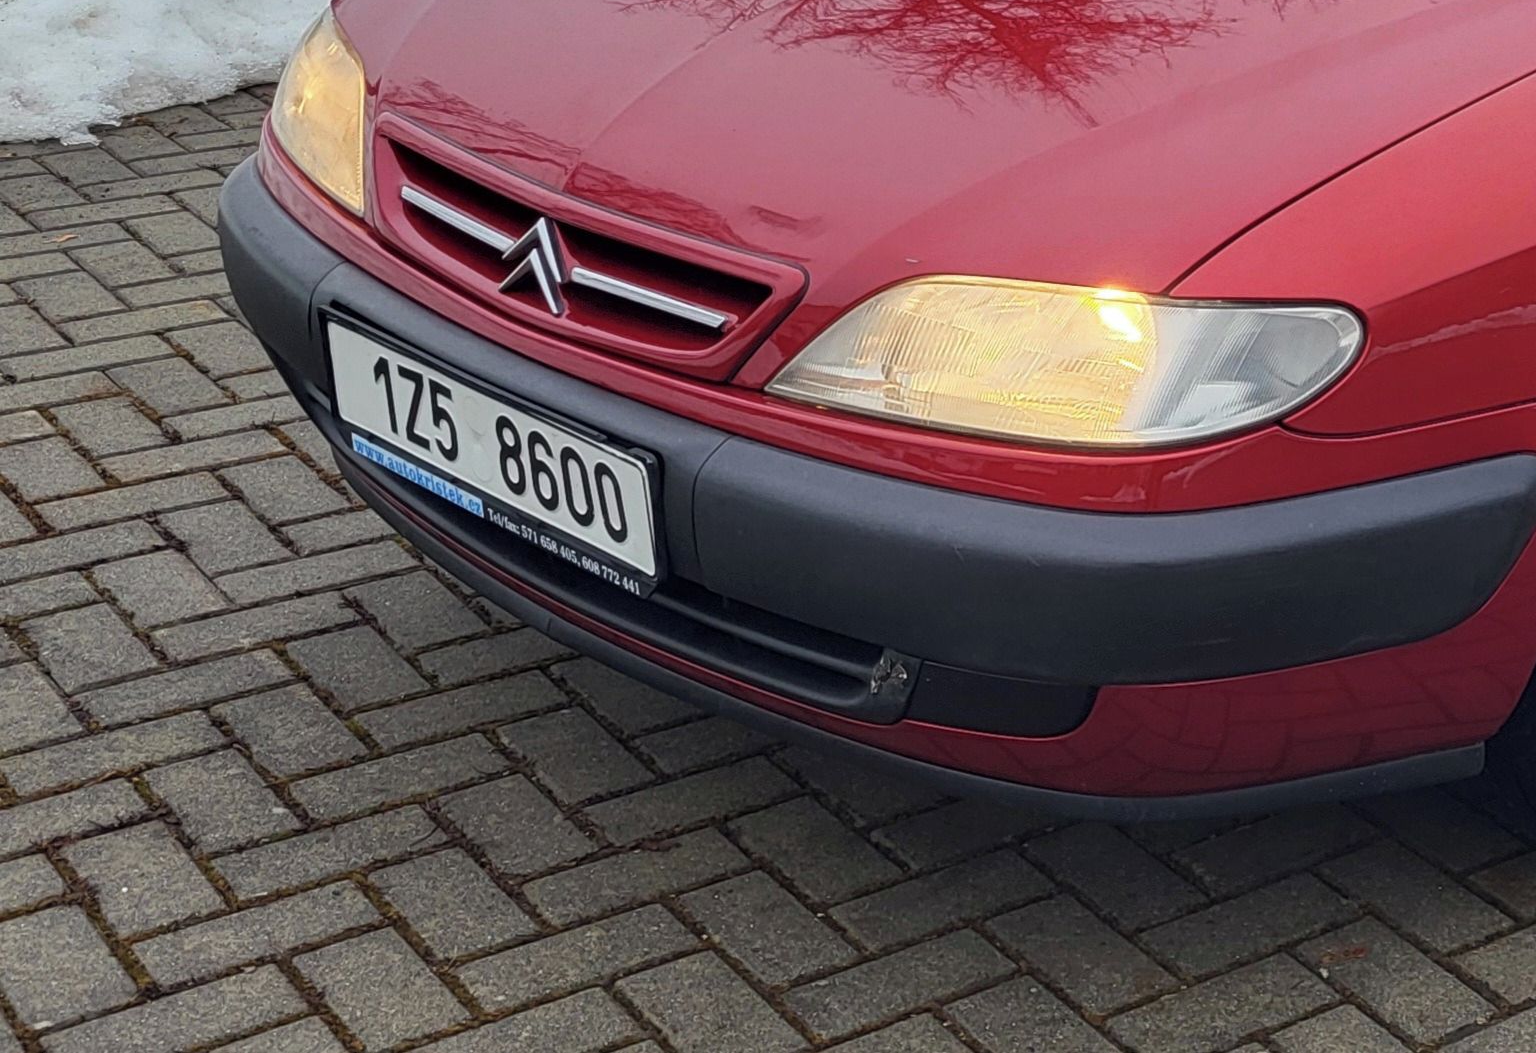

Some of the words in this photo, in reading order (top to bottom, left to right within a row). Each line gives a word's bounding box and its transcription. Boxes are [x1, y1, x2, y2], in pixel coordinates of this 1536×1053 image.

[354, 439, 482, 515] www.autokristek.cz
[521, 524, 538, 545] 571
[540, 534, 559, 555] 658
[582, 555, 601, 576] 608
[601, 565, 621, 586] 772
[622, 576, 641, 596] 441
[373, 356, 459, 462] 1Z5
[495, 415, 629, 544] 8600
